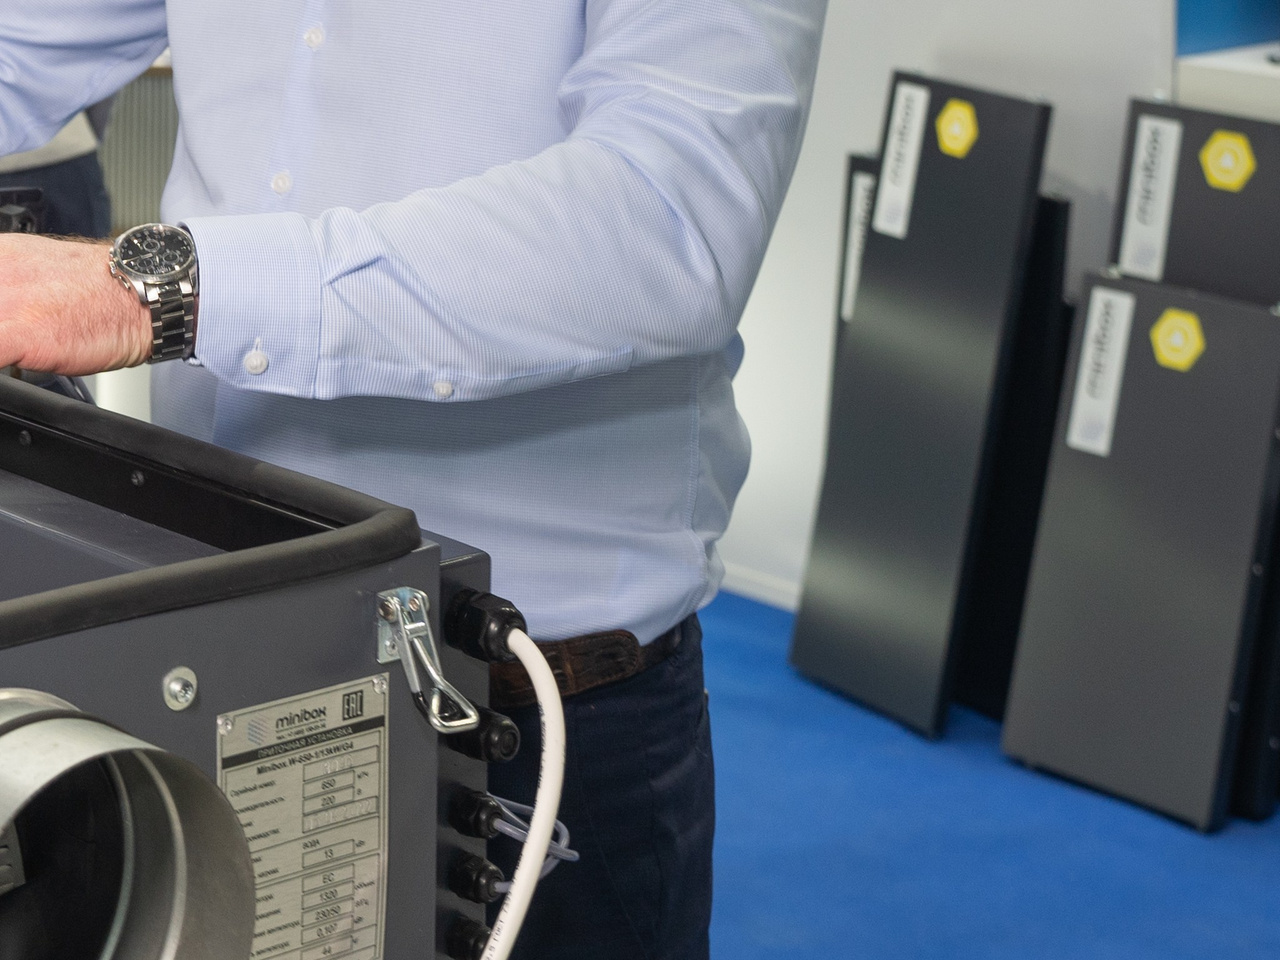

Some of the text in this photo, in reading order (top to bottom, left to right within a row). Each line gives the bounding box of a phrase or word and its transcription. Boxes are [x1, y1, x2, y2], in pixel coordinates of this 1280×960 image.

[274, 706, 327, 730] minibox
[306, 726, 353, 747] УСТАНОВКА
[321, 795, 336, 807] 220
